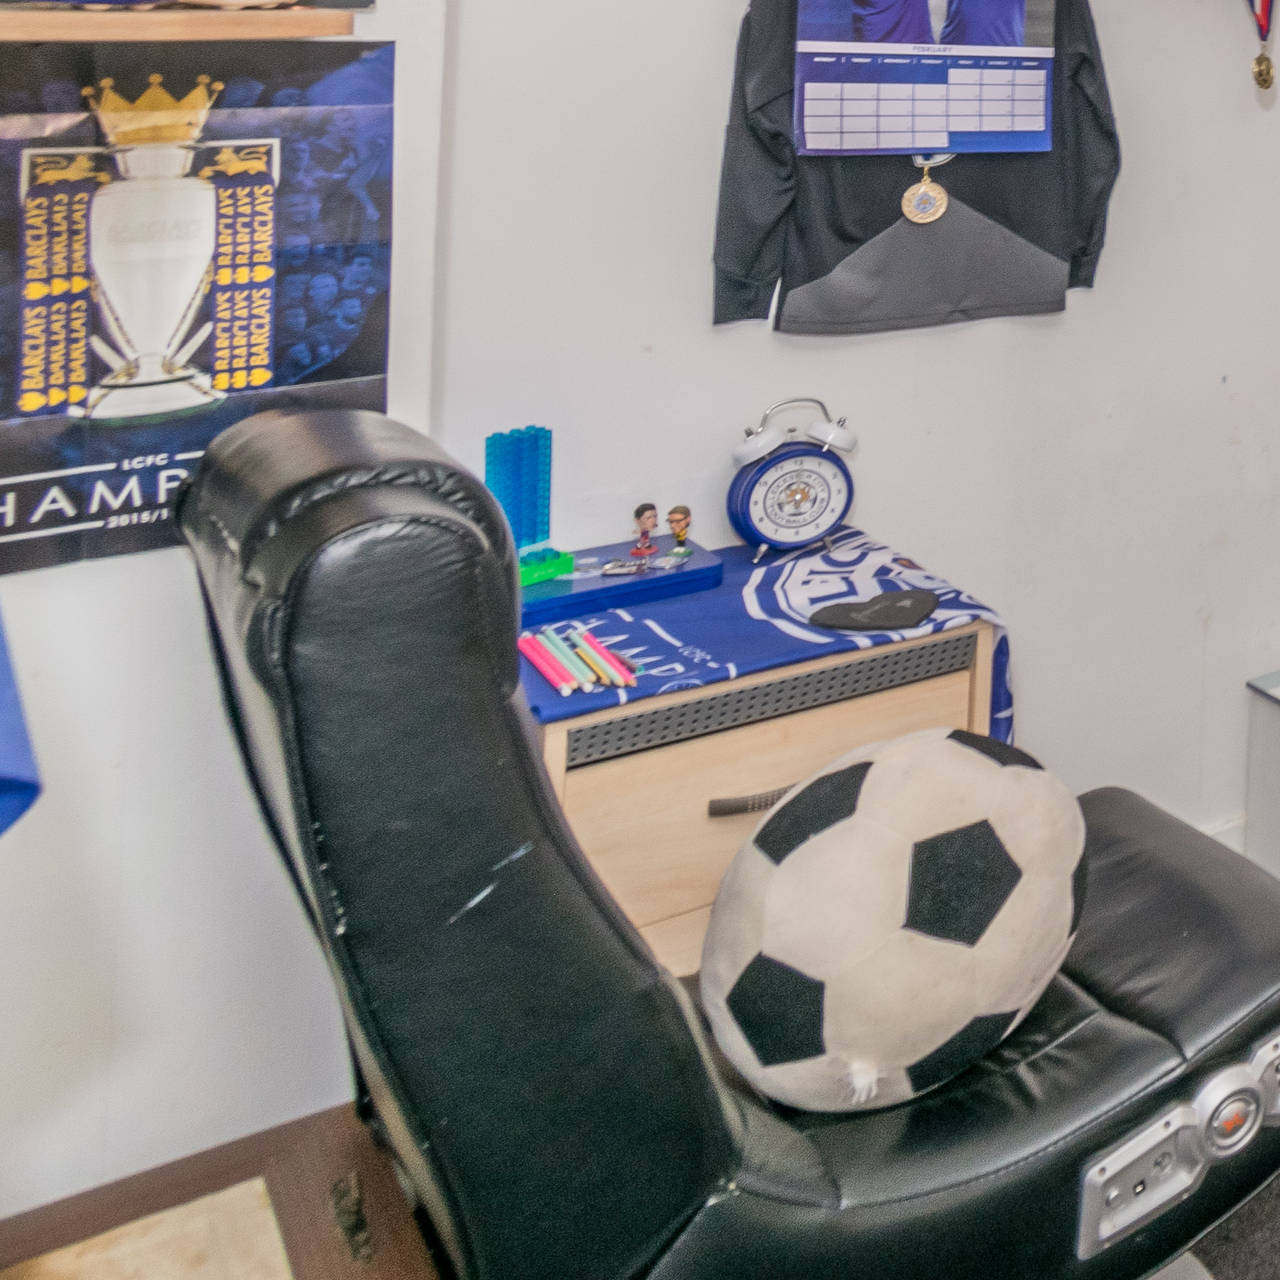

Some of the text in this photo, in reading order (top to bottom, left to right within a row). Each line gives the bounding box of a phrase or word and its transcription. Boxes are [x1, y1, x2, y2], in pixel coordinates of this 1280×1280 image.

[25, 197, 48, 279] BARCLAYS
[253, 185, 273, 263] BARCLAYS
[21, 306, 47, 389] BARCLAYS
[250, 288, 271, 367] BARCLAYS
[122, 453, 169, 470] LCFC
